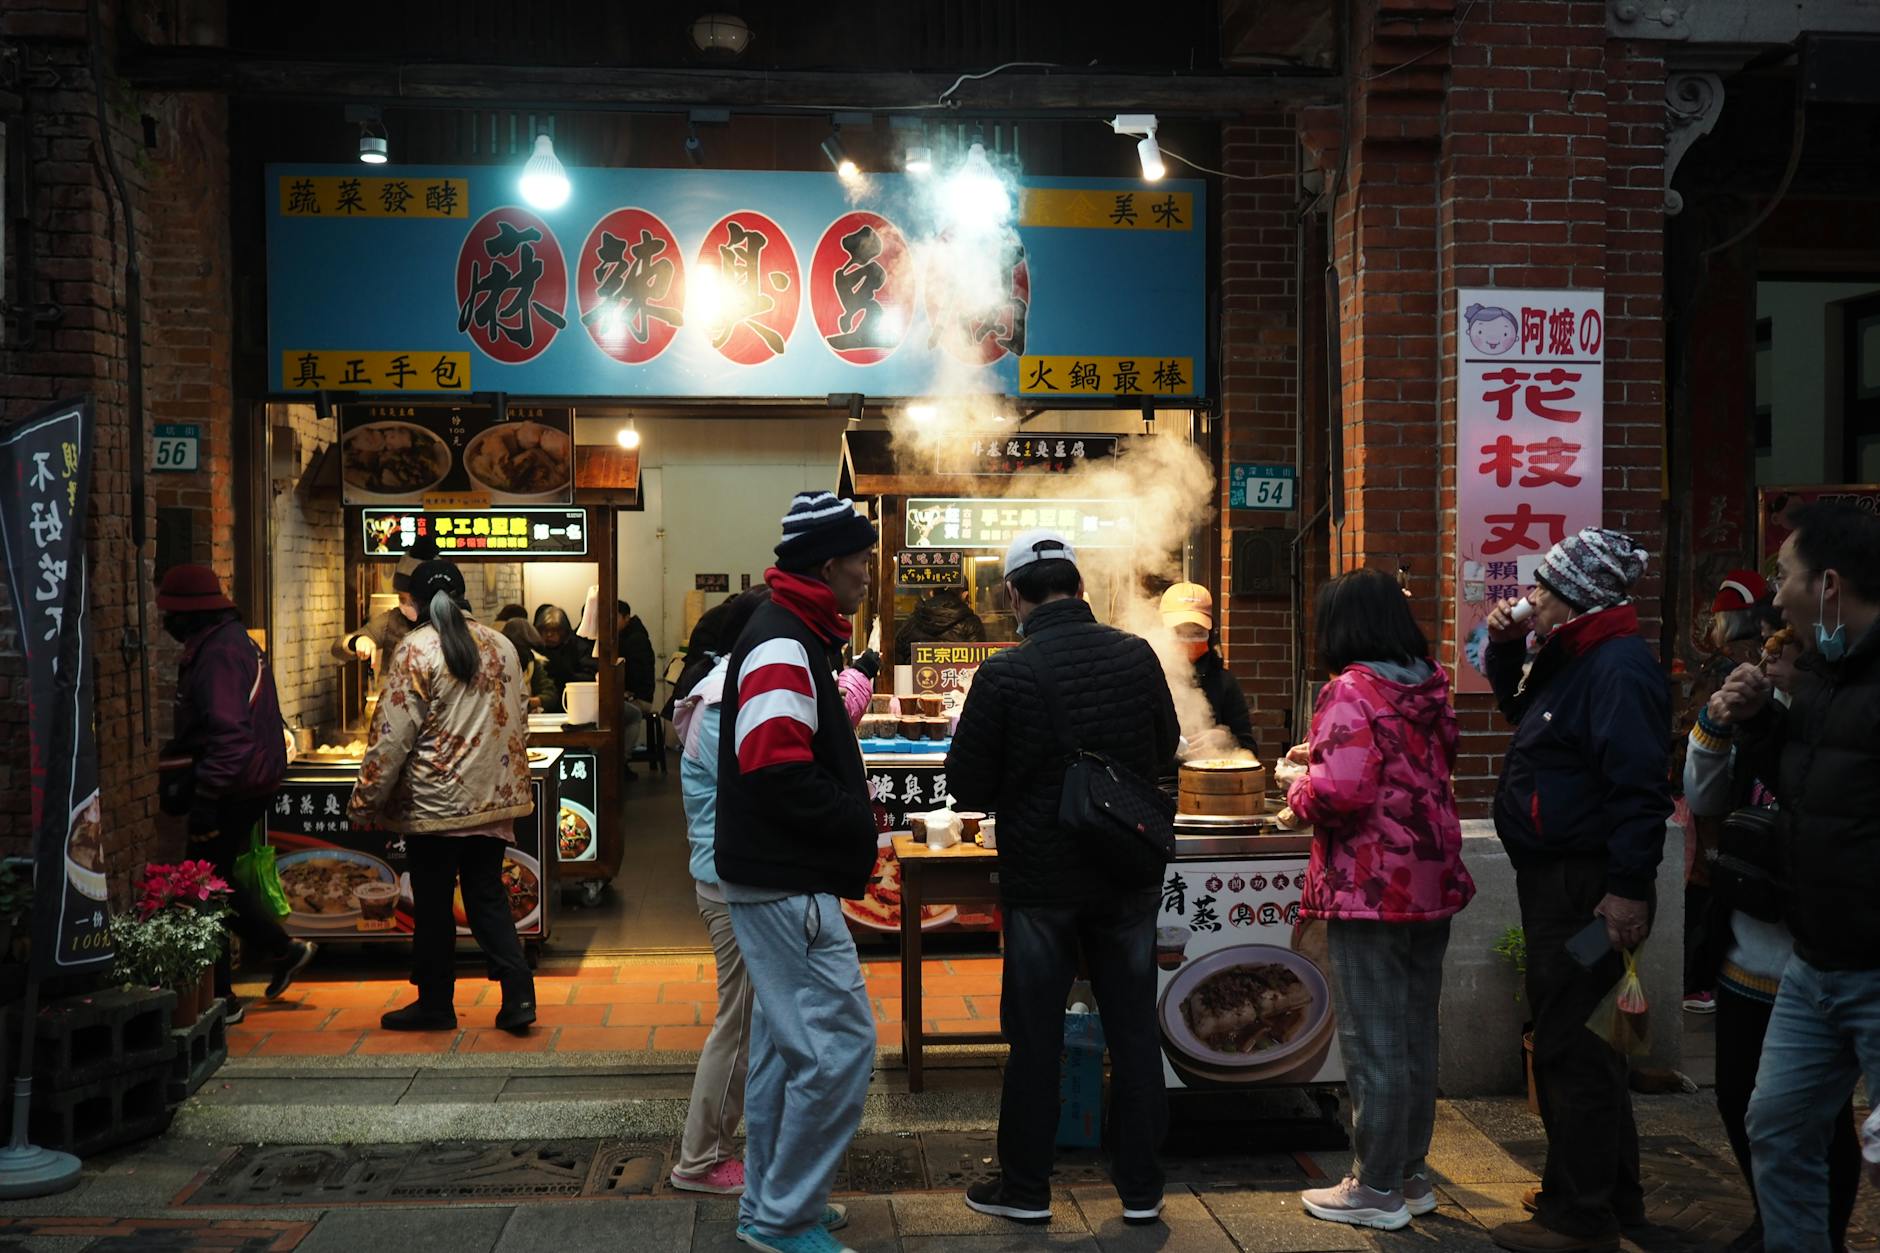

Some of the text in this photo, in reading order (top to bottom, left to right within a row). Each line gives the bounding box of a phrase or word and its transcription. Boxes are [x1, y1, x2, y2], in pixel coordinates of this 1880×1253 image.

[287, 179, 458, 215] 蔬菜發酵
[1521, 307, 1601, 355] 阿嬤の
[292, 352, 463, 389] 真正手包
[1028, 359, 1187, 393] 火鍋最棒
[157, 441, 186, 466] 56
[1479, 367, 1583, 555] 花枝丸
[1257, 481, 1284, 504] 54
[1487, 561, 1518, 581] 顆
[275, 793, 341, 816] 清蒸臭
